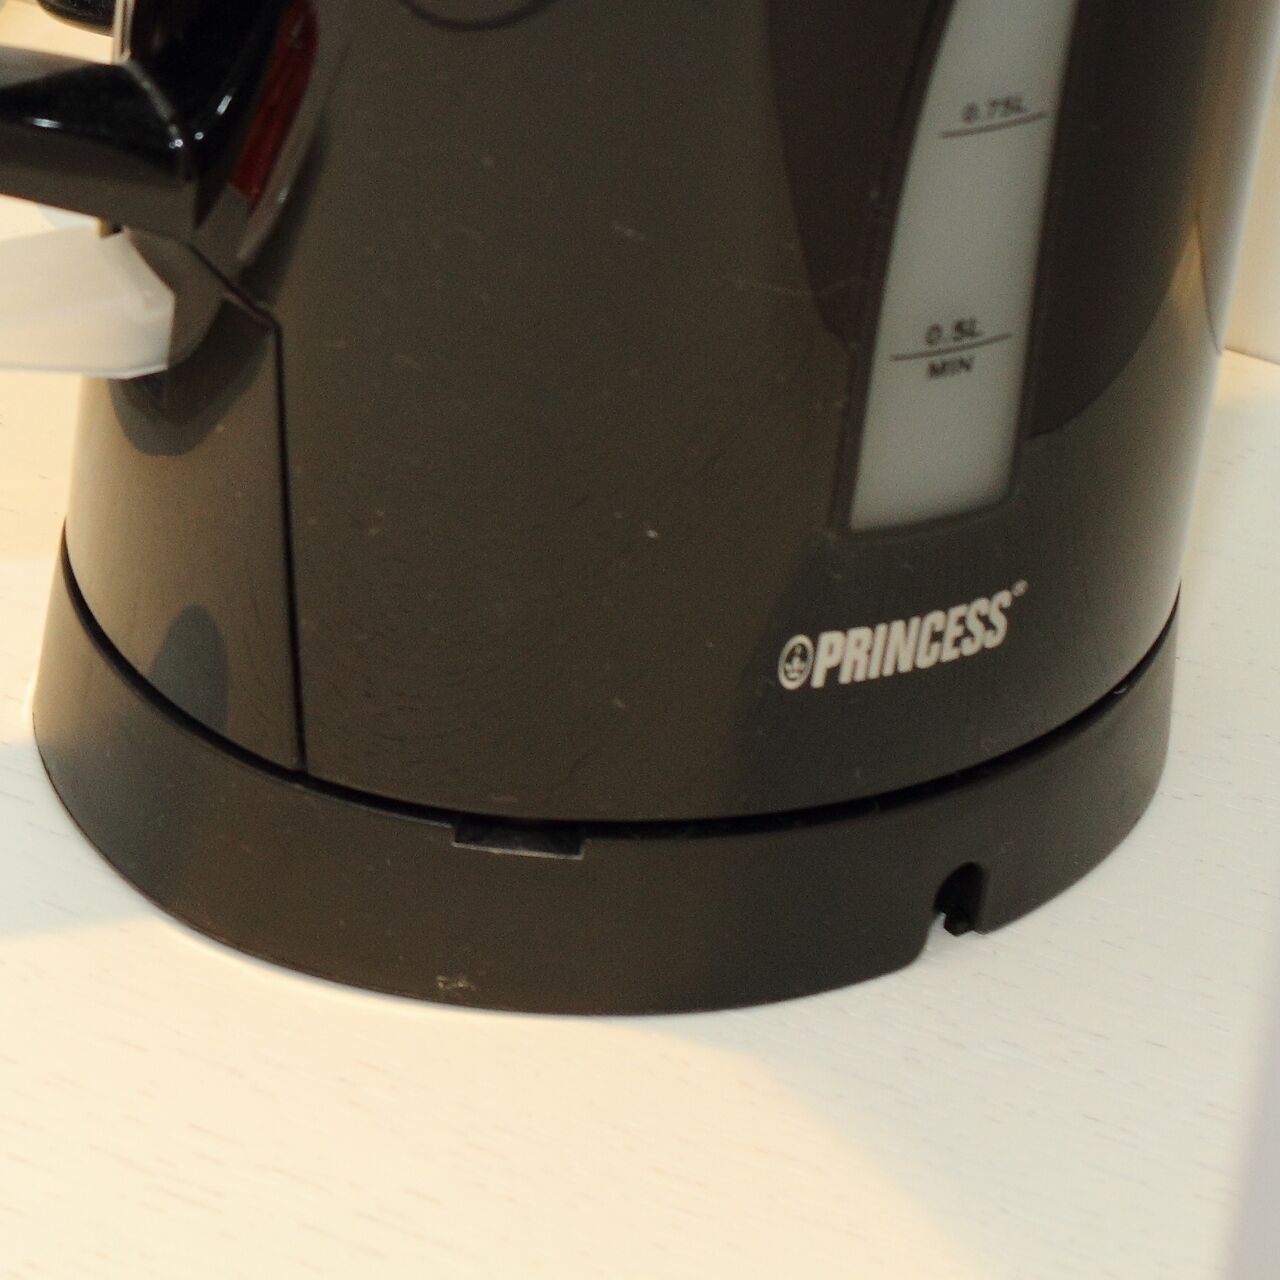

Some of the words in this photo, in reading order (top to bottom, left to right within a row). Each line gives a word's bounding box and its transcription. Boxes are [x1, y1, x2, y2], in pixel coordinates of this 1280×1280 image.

[925, 320, 981, 344] 0.5L
[927, 356, 974, 379] MIN
[810, 589, 1013, 689] PRINCESS
